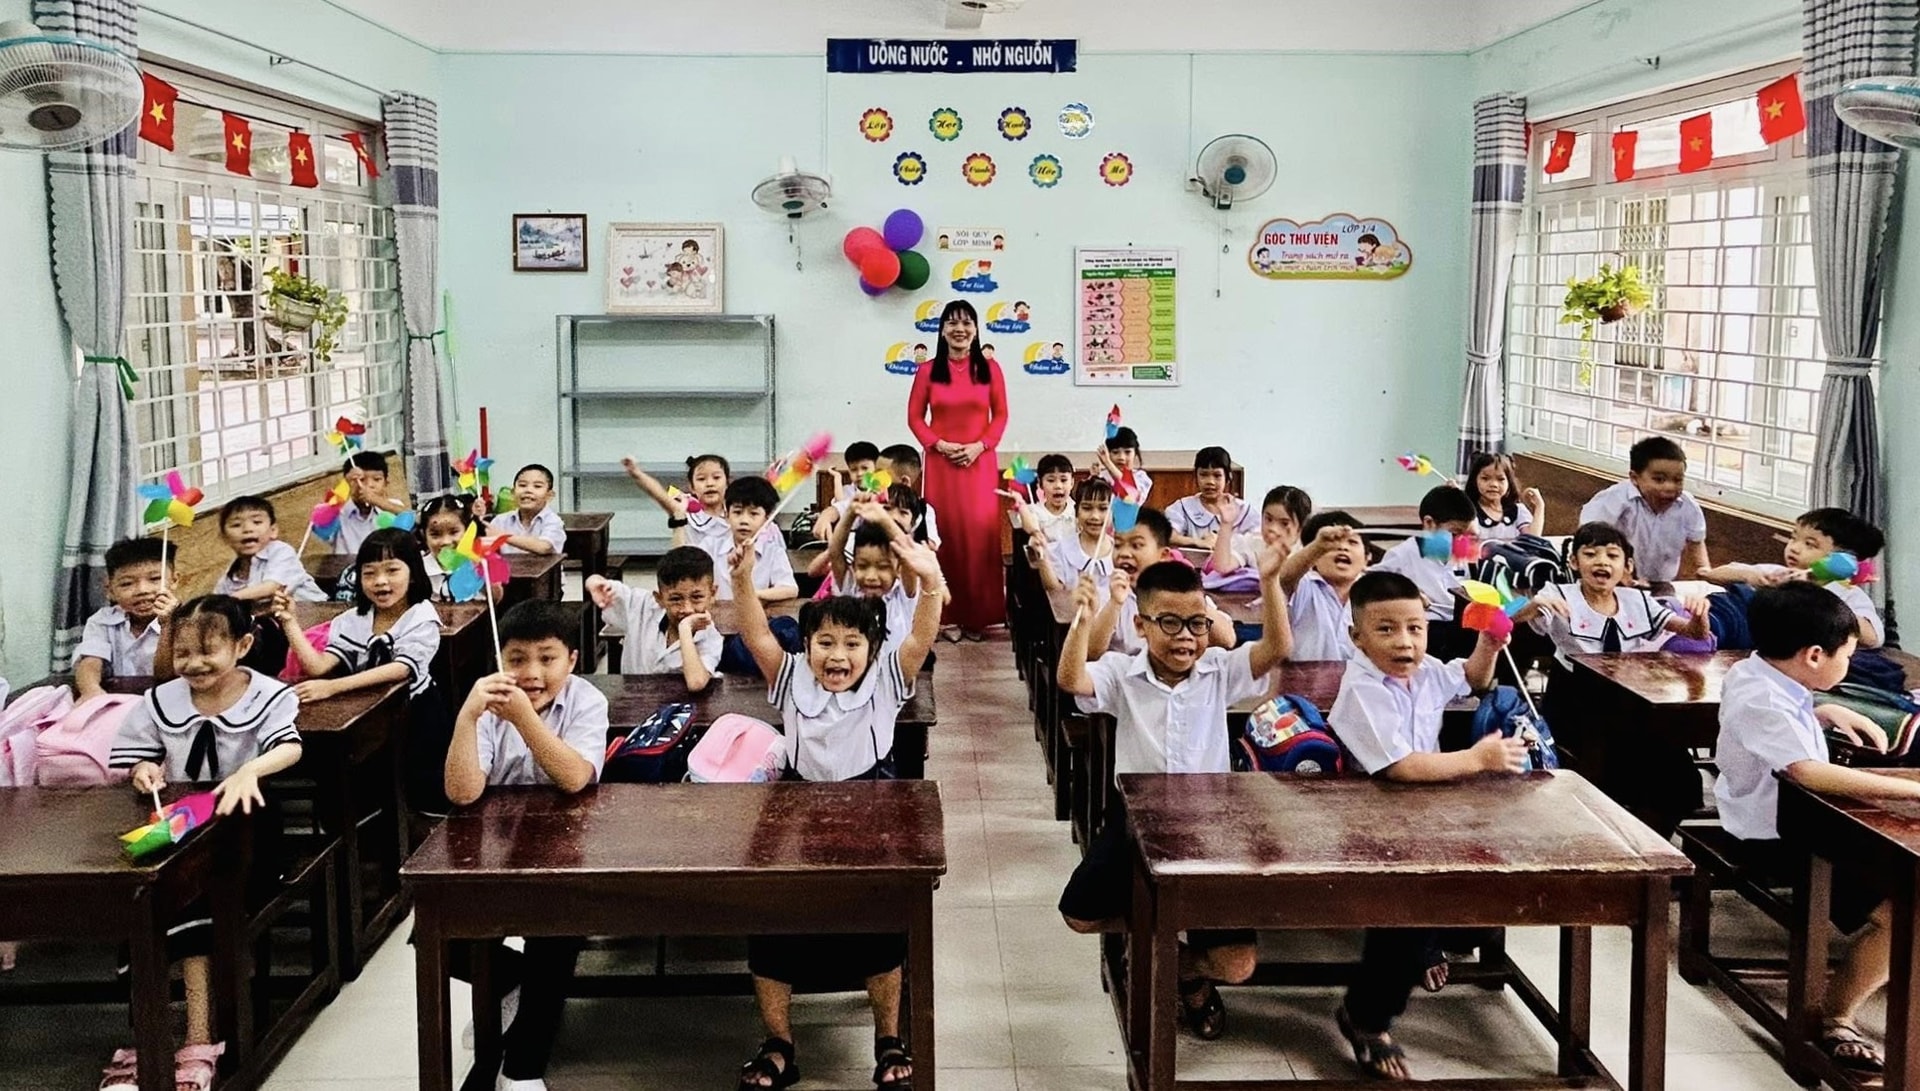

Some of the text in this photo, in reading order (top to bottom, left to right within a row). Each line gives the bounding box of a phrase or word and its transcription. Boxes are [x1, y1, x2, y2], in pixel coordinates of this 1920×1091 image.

[911, 42, 948, 65] NƯỚC
[973, 42, 1002, 66] NHỚ
[1342, 223, 1376, 233] LỚP 1/4
[1290, 232, 1311, 245] THƯ
[1313, 231, 1338, 248] VIỆN
